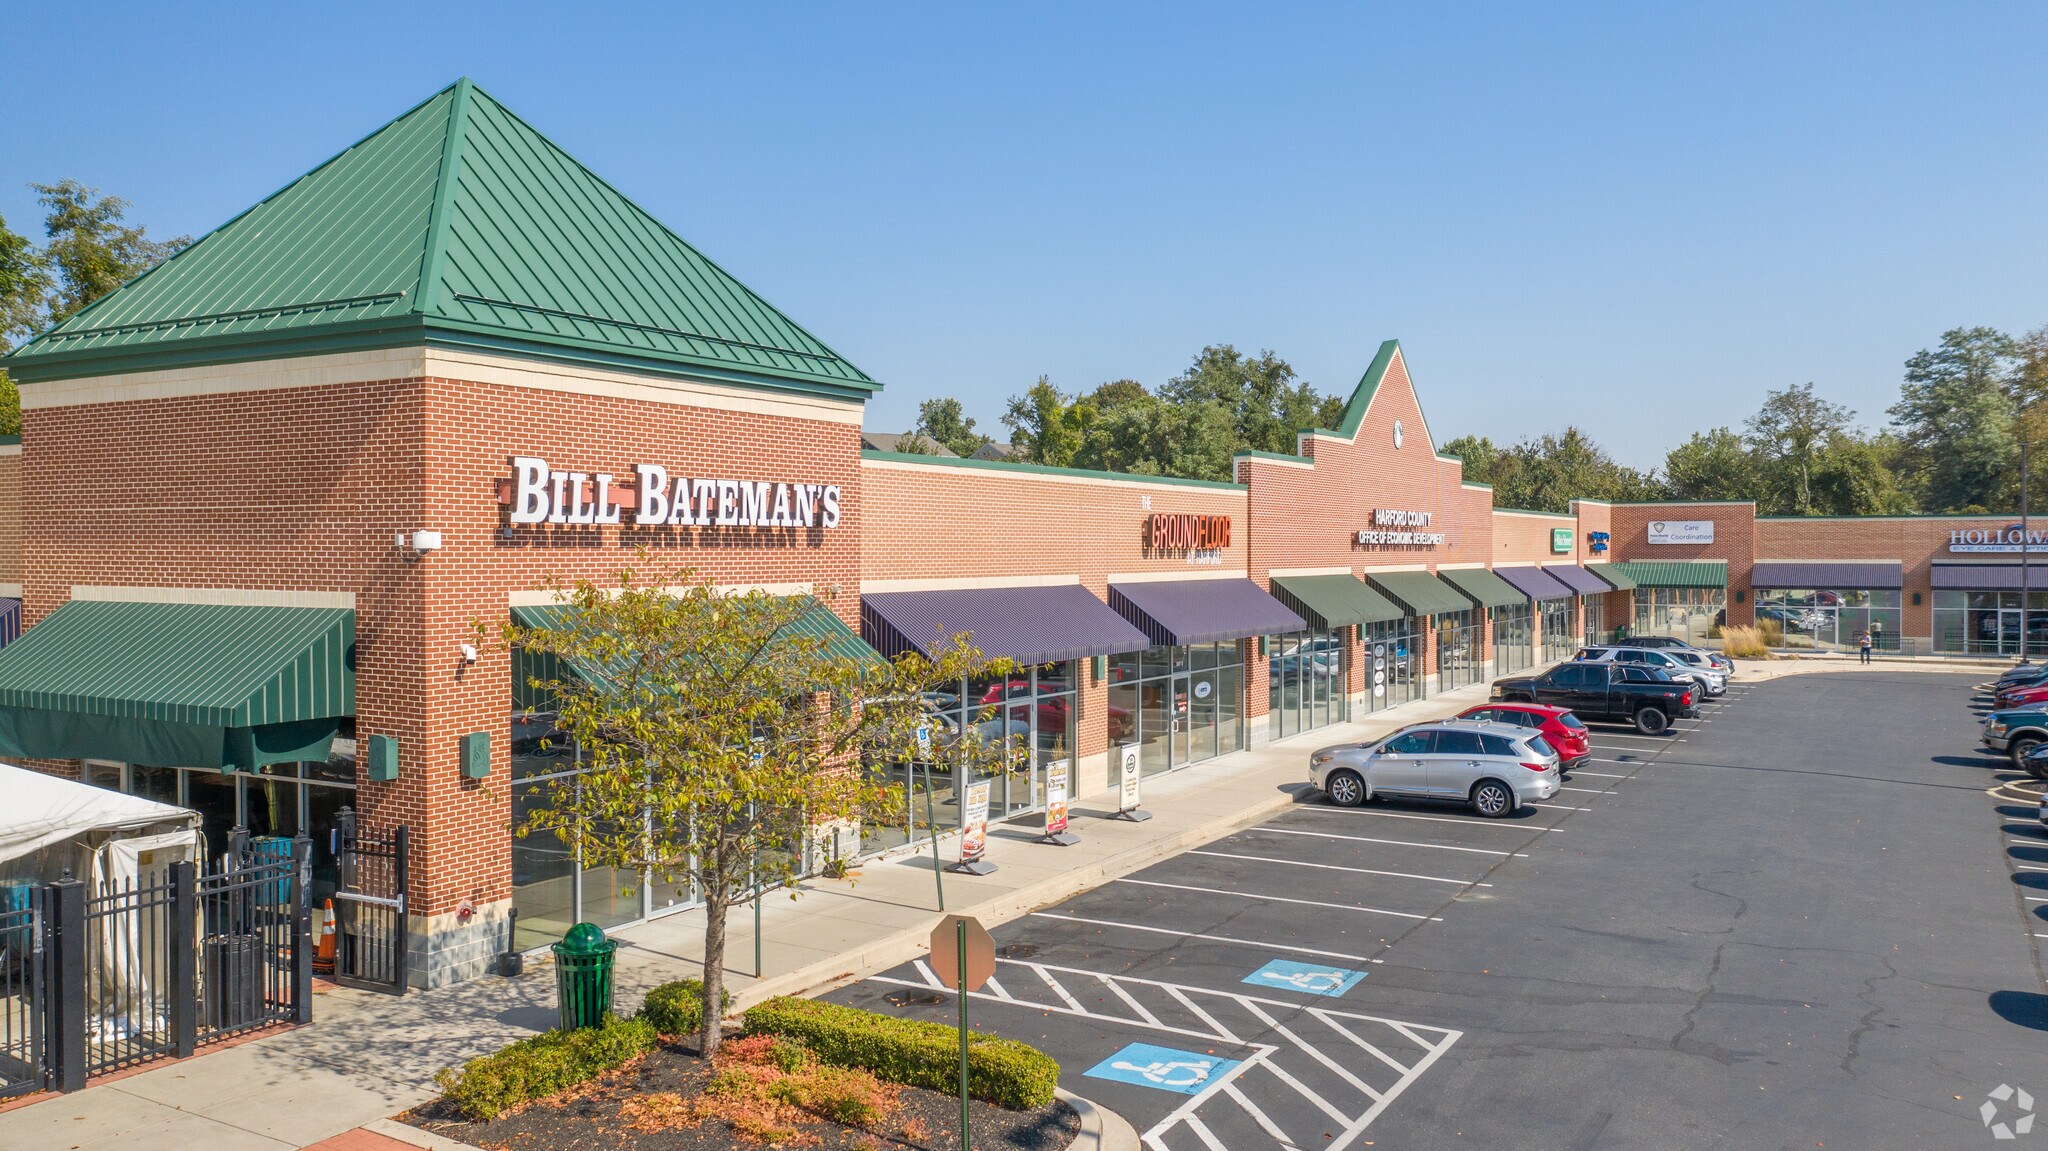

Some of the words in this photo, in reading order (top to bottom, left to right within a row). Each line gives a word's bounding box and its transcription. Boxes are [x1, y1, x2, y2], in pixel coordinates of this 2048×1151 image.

[510, 456, 620, 525] BILL
[635, 463, 841, 529] BATEMAN'S
[1141, 495, 1152, 511] THE
[1375, 508, 1407, 526] HARFORD
[1407, 510, 1432, 527] COUNTY
[1152, 513, 1232, 550] GROUNDFLOOR
[1359, 530, 1379, 544] OFFICE
[1379, 531, 1387, 544] OF
[1387, 531, 1413, 545] ECONOMIC
[1413, 532, 1445, 545] DEVELOPMENT
[1671, 533, 1712, 541] Coordination
